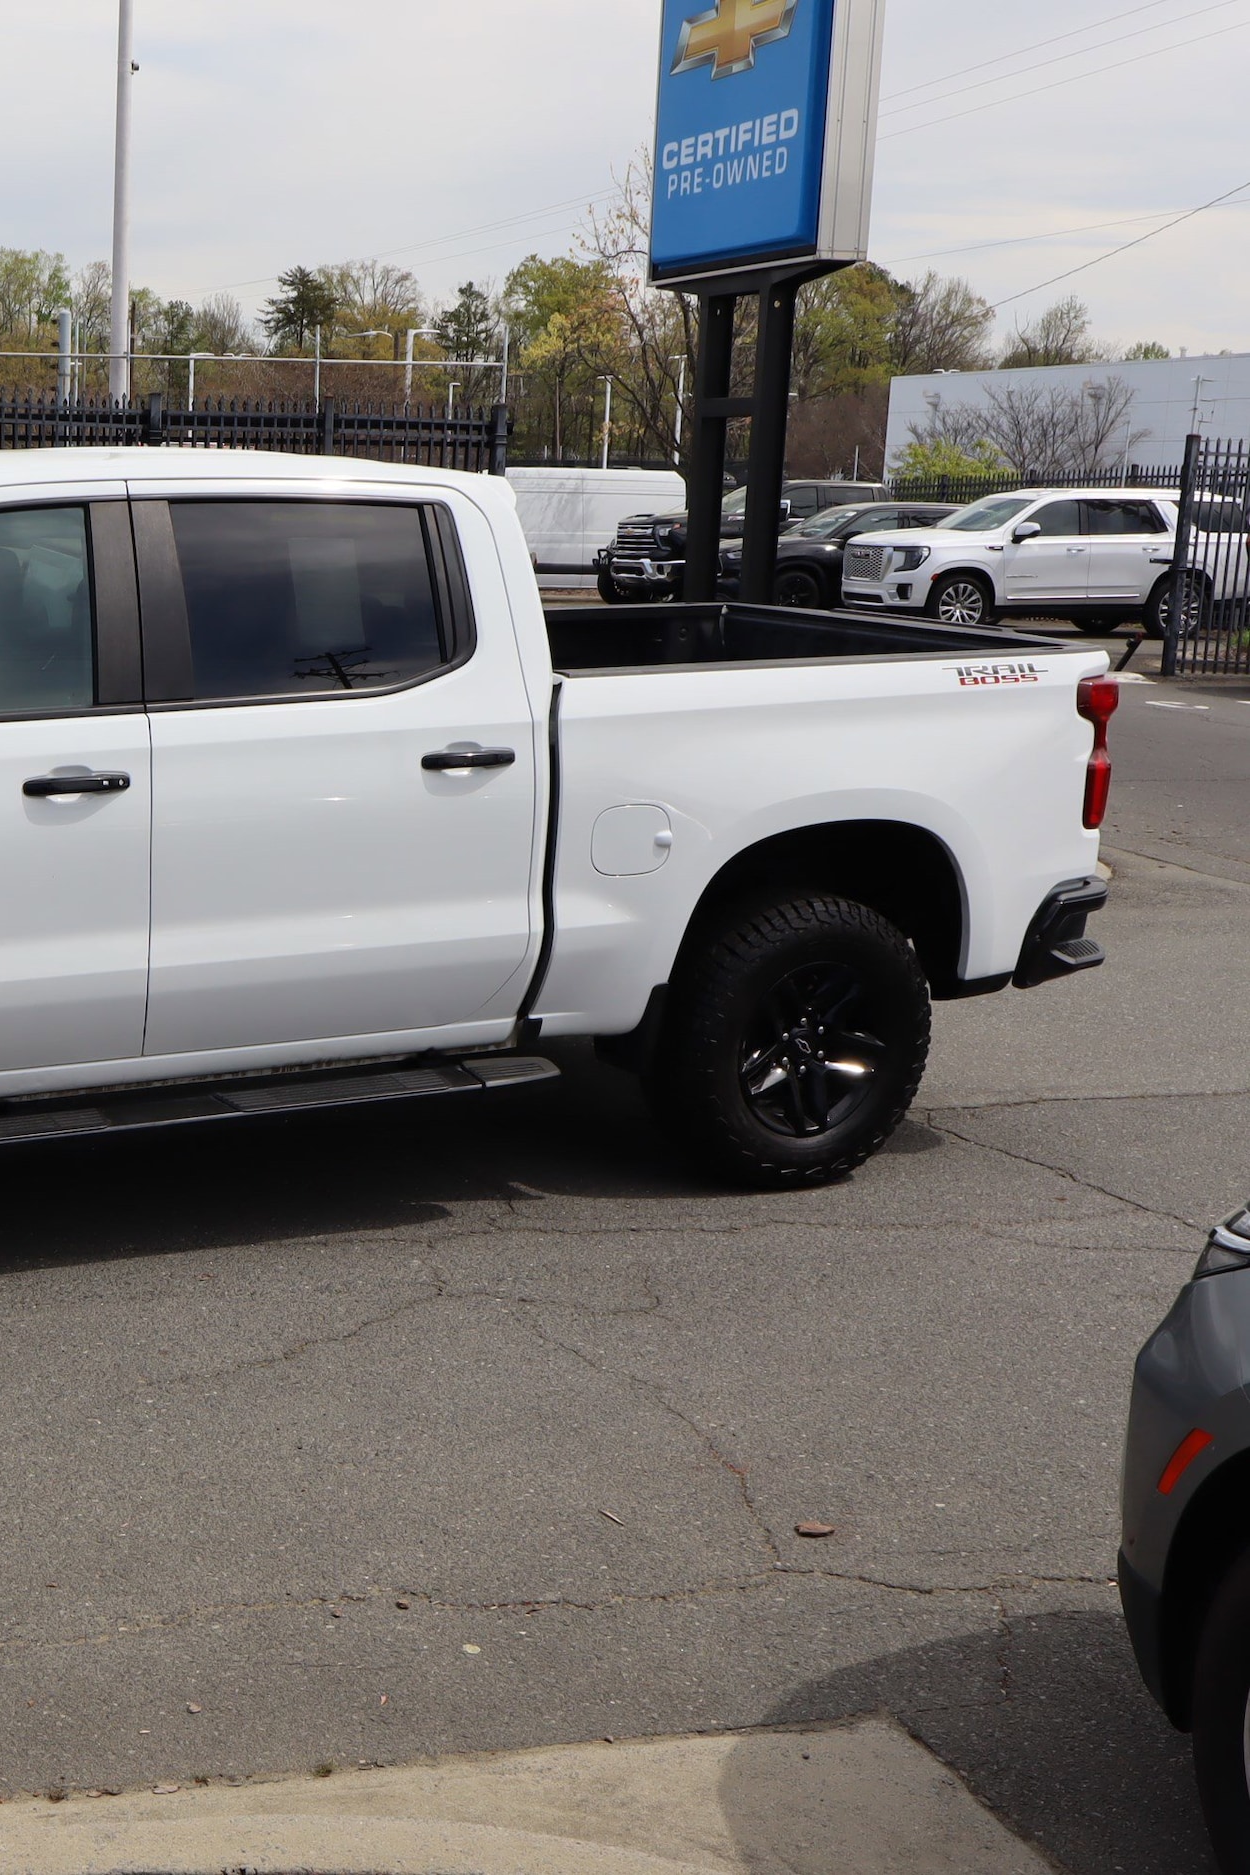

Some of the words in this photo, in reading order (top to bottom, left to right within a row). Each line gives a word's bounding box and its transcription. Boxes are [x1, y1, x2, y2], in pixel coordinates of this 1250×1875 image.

[662, 108, 799, 170] CERTIFIED
[667, 146, 788, 200] PRE-OWNED
[942, 663, 1049, 677] TRAIL
[959, 673, 1038, 686] BOSS
